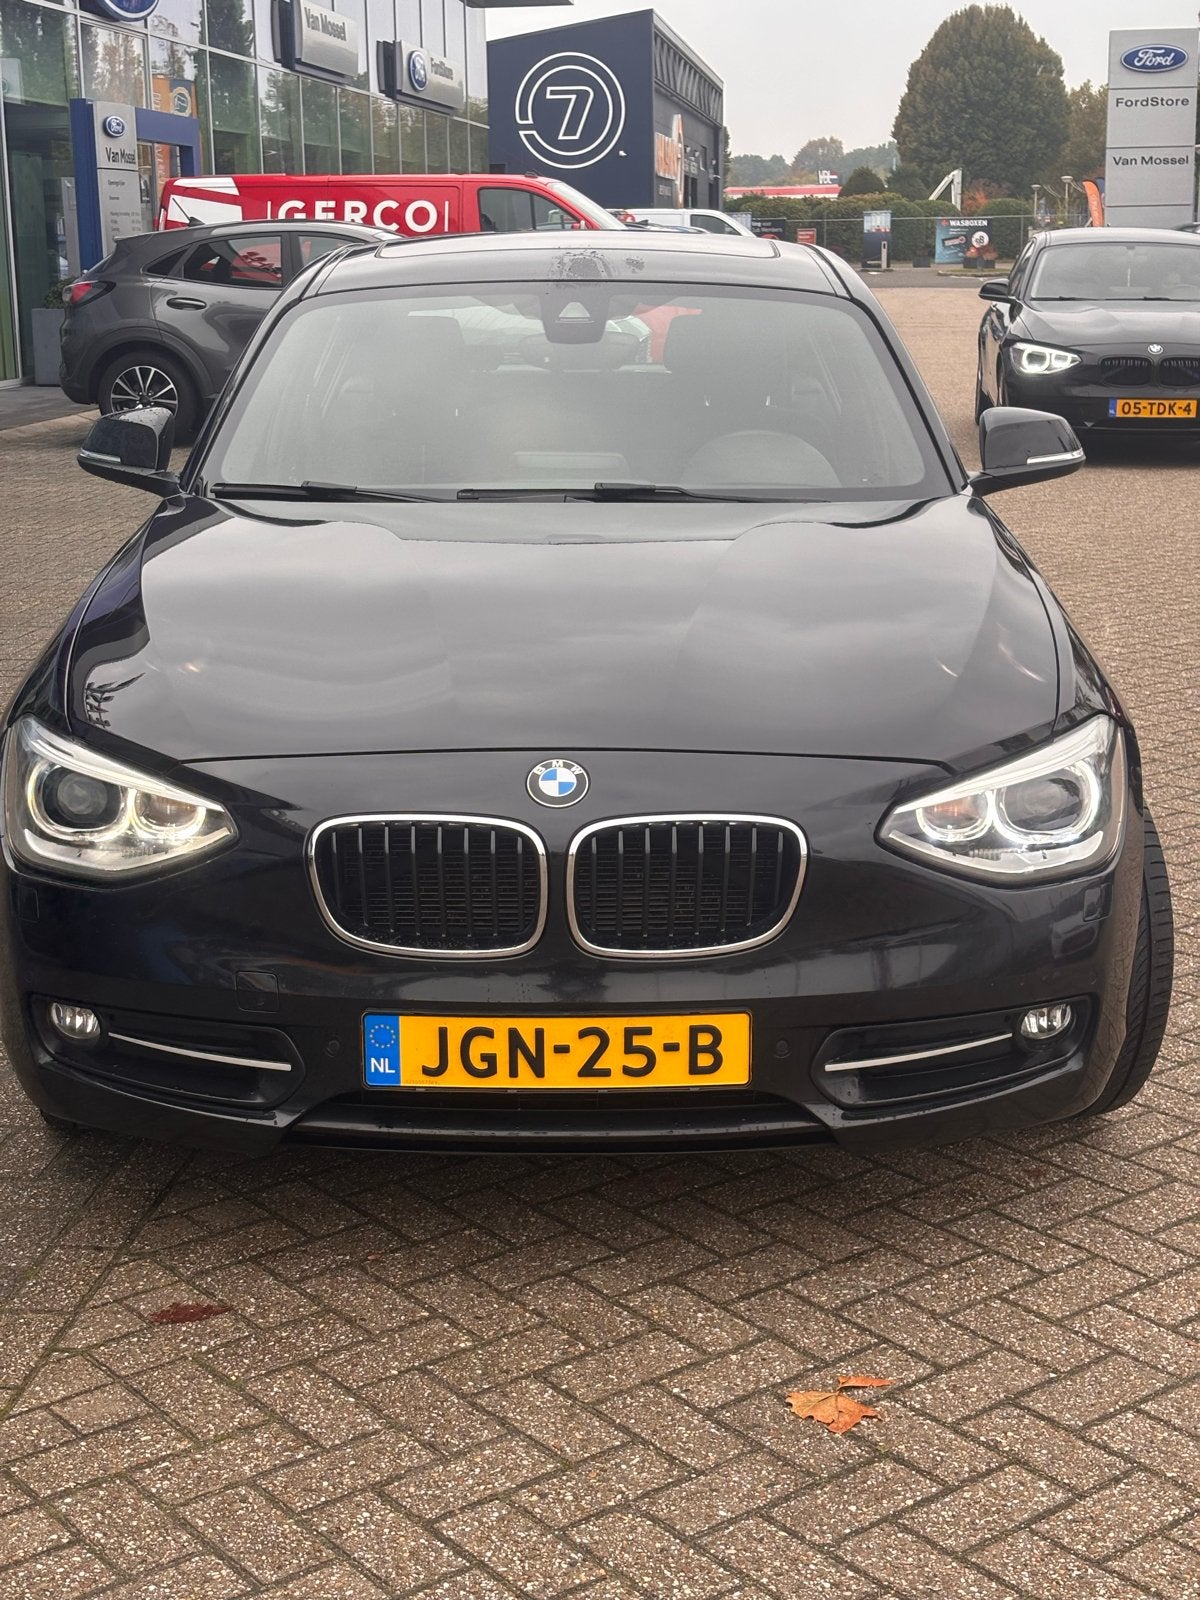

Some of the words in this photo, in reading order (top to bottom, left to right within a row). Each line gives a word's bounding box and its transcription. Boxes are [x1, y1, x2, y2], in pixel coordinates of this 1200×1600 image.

[304, 7, 320, 31] Van
[320, 13, 347, 41] Mossel
[1134, 49, 1174, 66] Ford
[1115, 96, 1190, 108] FordStore
[546, 86, 594, 140] 7
[105, 147, 120, 163] Van
[120, 149, 136, 165] Mossel
[1113, 156, 1137, 166] Van
[1141, 155, 1189, 165] Mossel
[278, 200, 438, 232] GERCO
[949, 219, 988, 227] WASBOXEN
[1122, 402, 1192, 415] 05-TDK-4
[533, 760, 583, 775] BMW
[422, 1024, 723, 1079] JGN-25-B
[370, 1057, 395, 1074] NL
